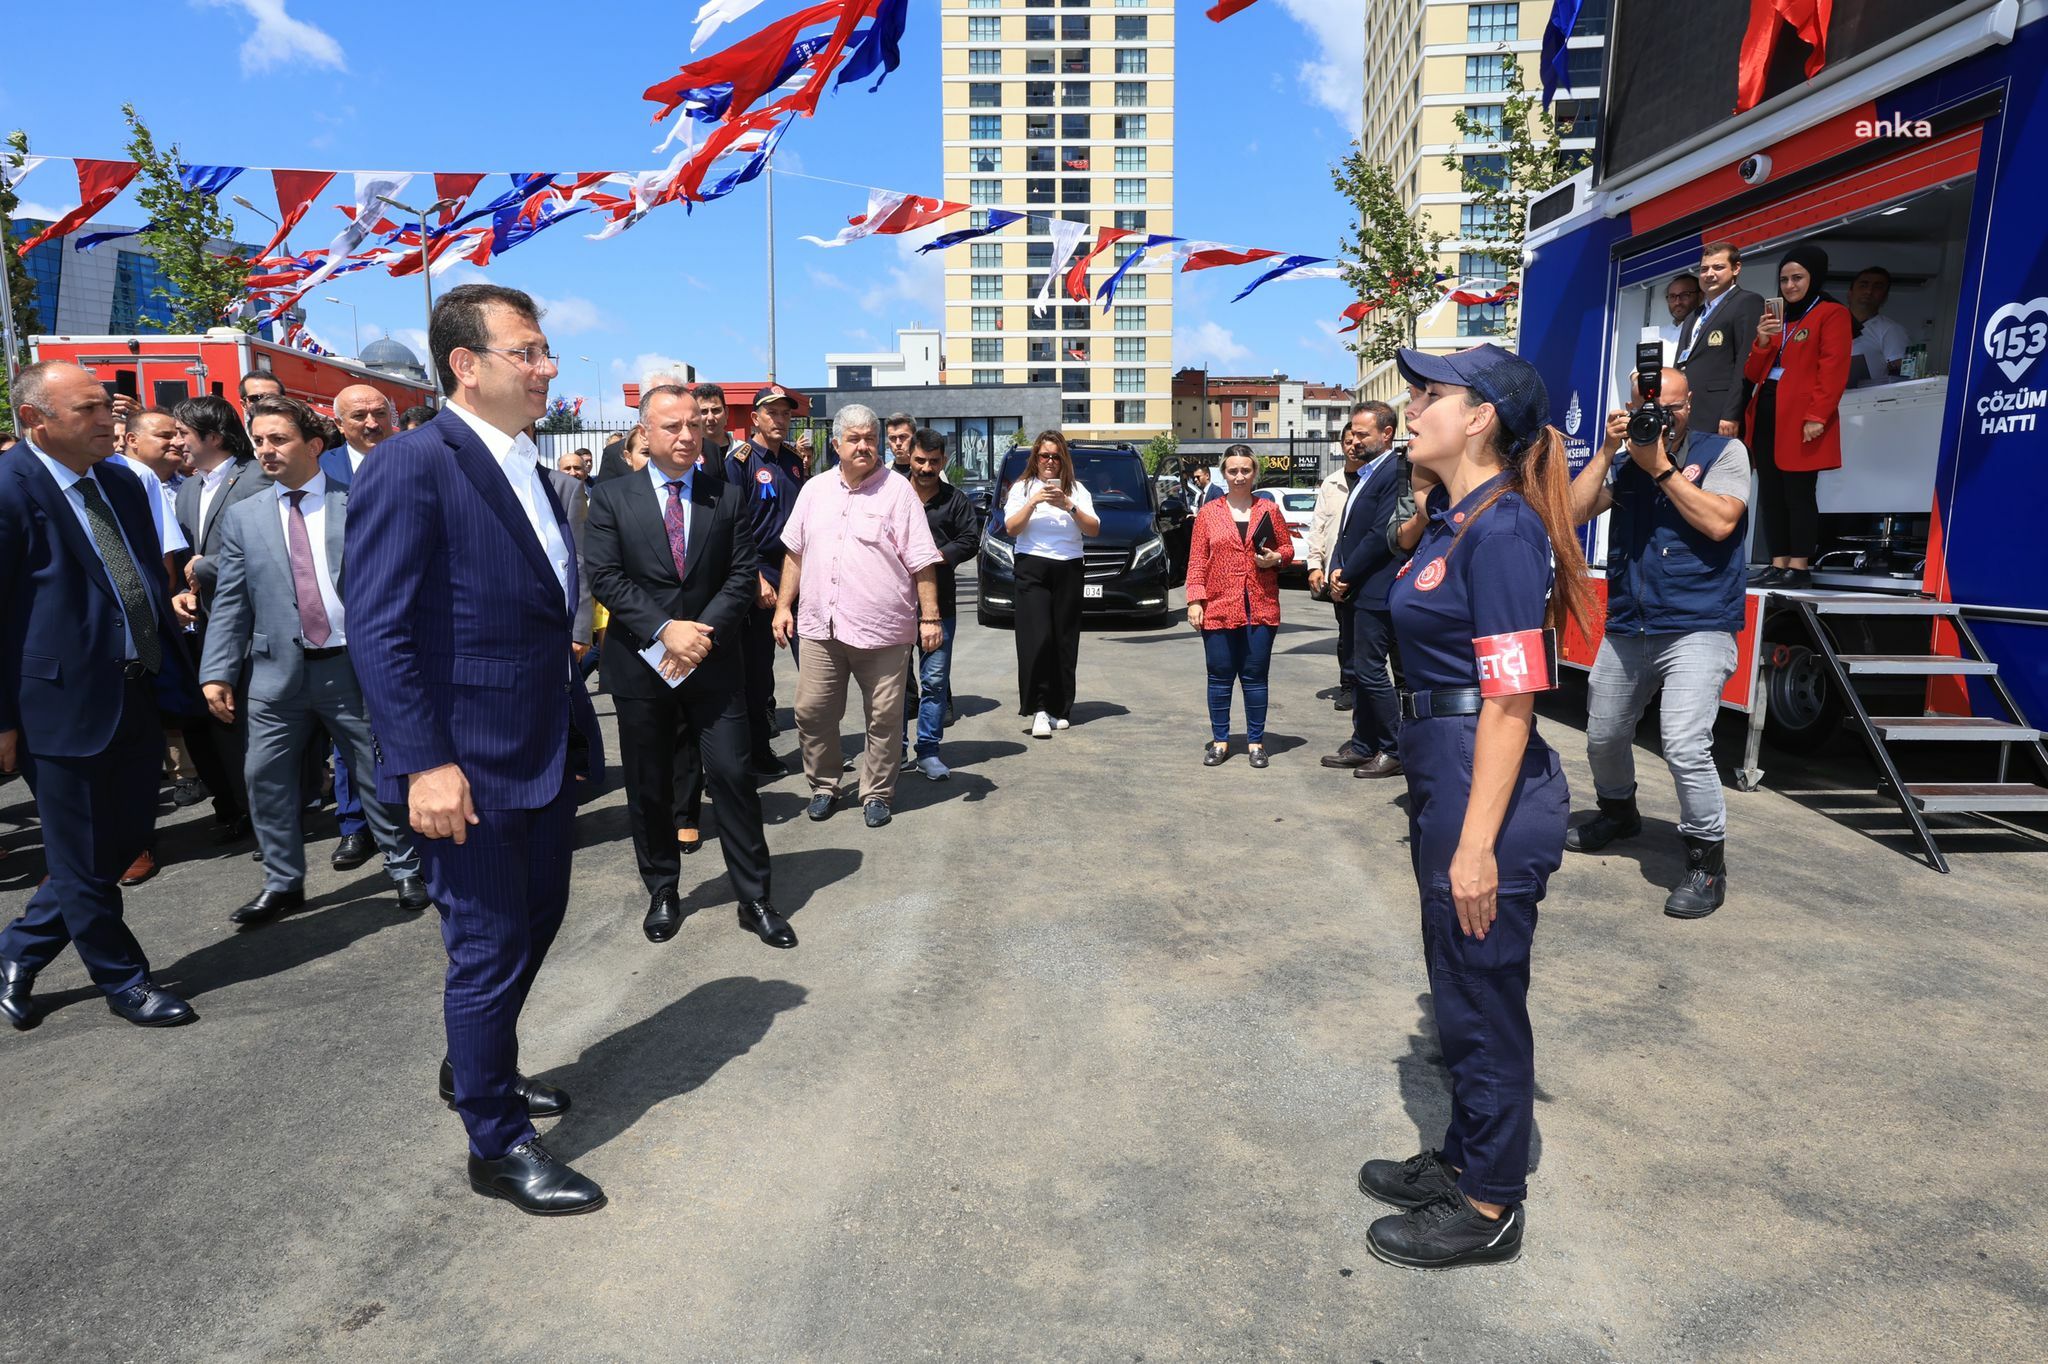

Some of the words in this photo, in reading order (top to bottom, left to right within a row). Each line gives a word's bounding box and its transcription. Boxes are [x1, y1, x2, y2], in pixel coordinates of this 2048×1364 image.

[1993, 322, 2048, 359] 153
[1976, 387, 2048, 416] ÇÖZÜM
[1980, 413, 2036, 434] HATTI
